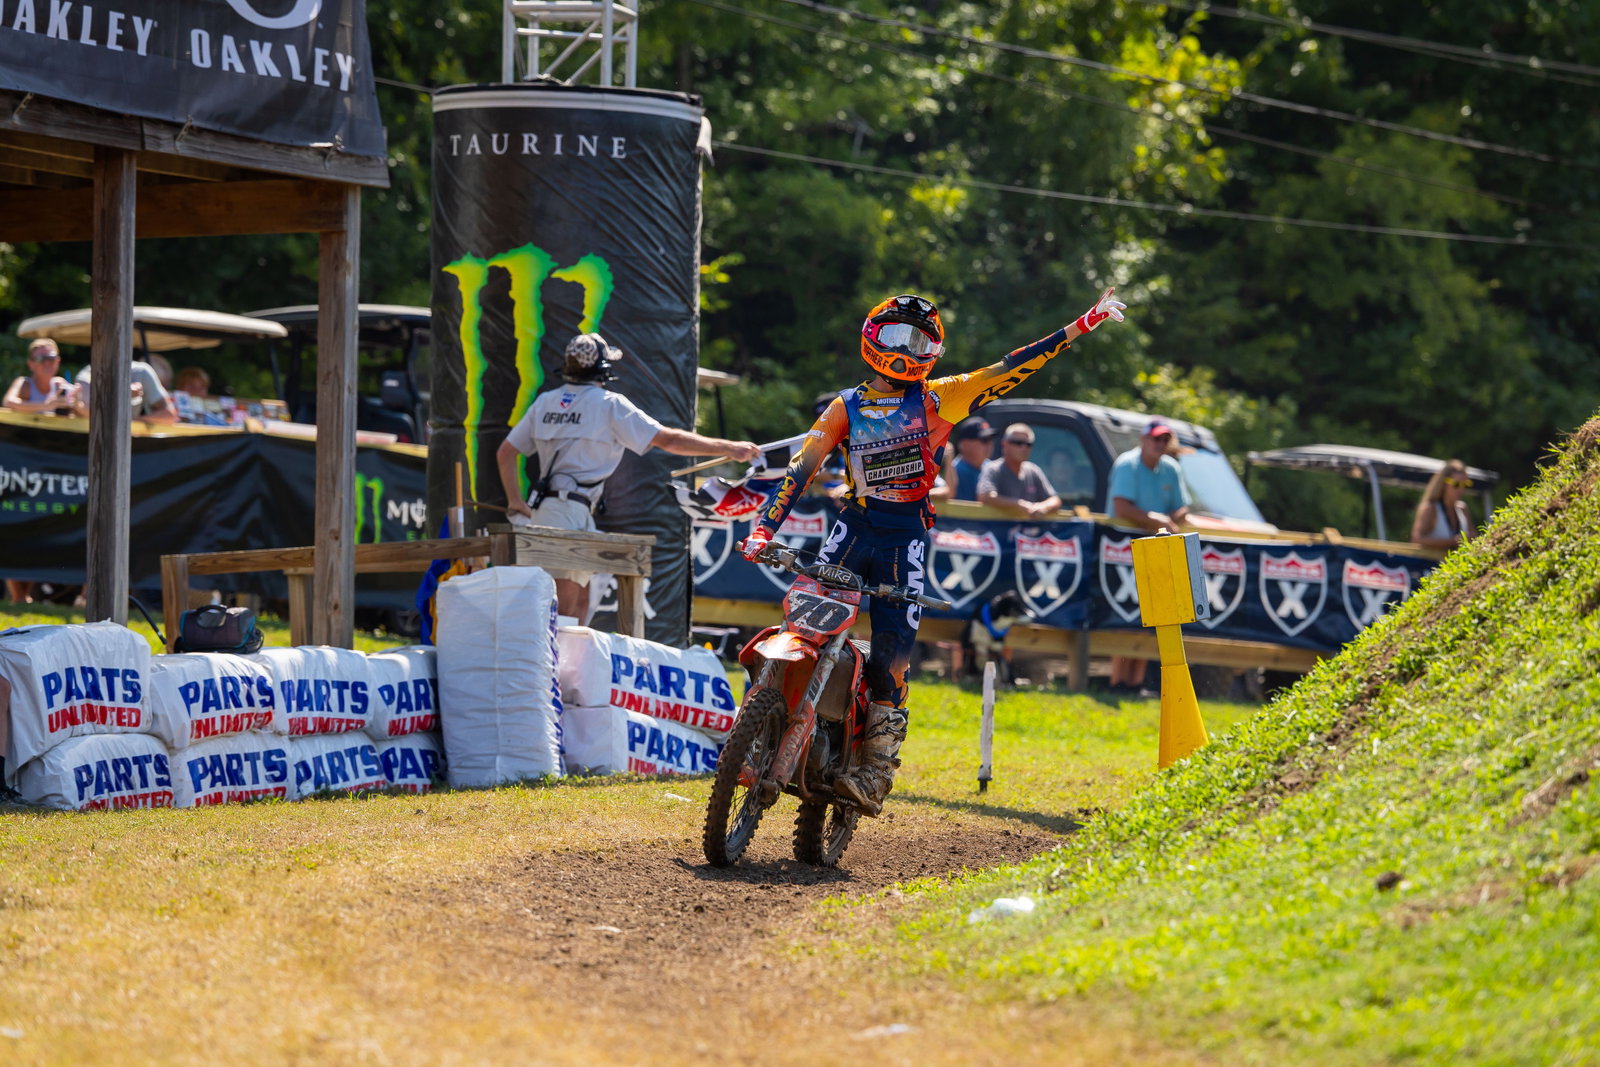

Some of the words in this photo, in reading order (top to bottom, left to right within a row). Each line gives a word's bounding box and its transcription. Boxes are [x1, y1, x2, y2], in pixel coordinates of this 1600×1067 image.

[0, 0, 154, 57] AKLEY
[190, 28, 355, 92] OAKLEY
[450, 132, 627, 159] TAURINE
[0, 465, 89, 498] ONSTER
[867, 461, 922, 480] CHAMPIONSHIP
[2, 500, 79, 515] NERGY
[941, 553, 983, 592] X
[1028, 561, 1066, 600] X
[786, 593, 851, 632] 70
[1276, 580, 1309, 620] X
[41, 665, 142, 710] PARTS
[178, 675, 275, 719] PARTS
[280, 678, 369, 714] PARTS
[610, 652, 736, 712] PARTS
[190, 710, 273, 740] NLIMITED
[609, 687, 735, 733] UNLIMITED
[626, 720, 719, 774] PARTS
[73, 753, 172, 802] PARTS
[187, 748, 288, 794] PARTS
[294, 744, 384, 793] PARTS
